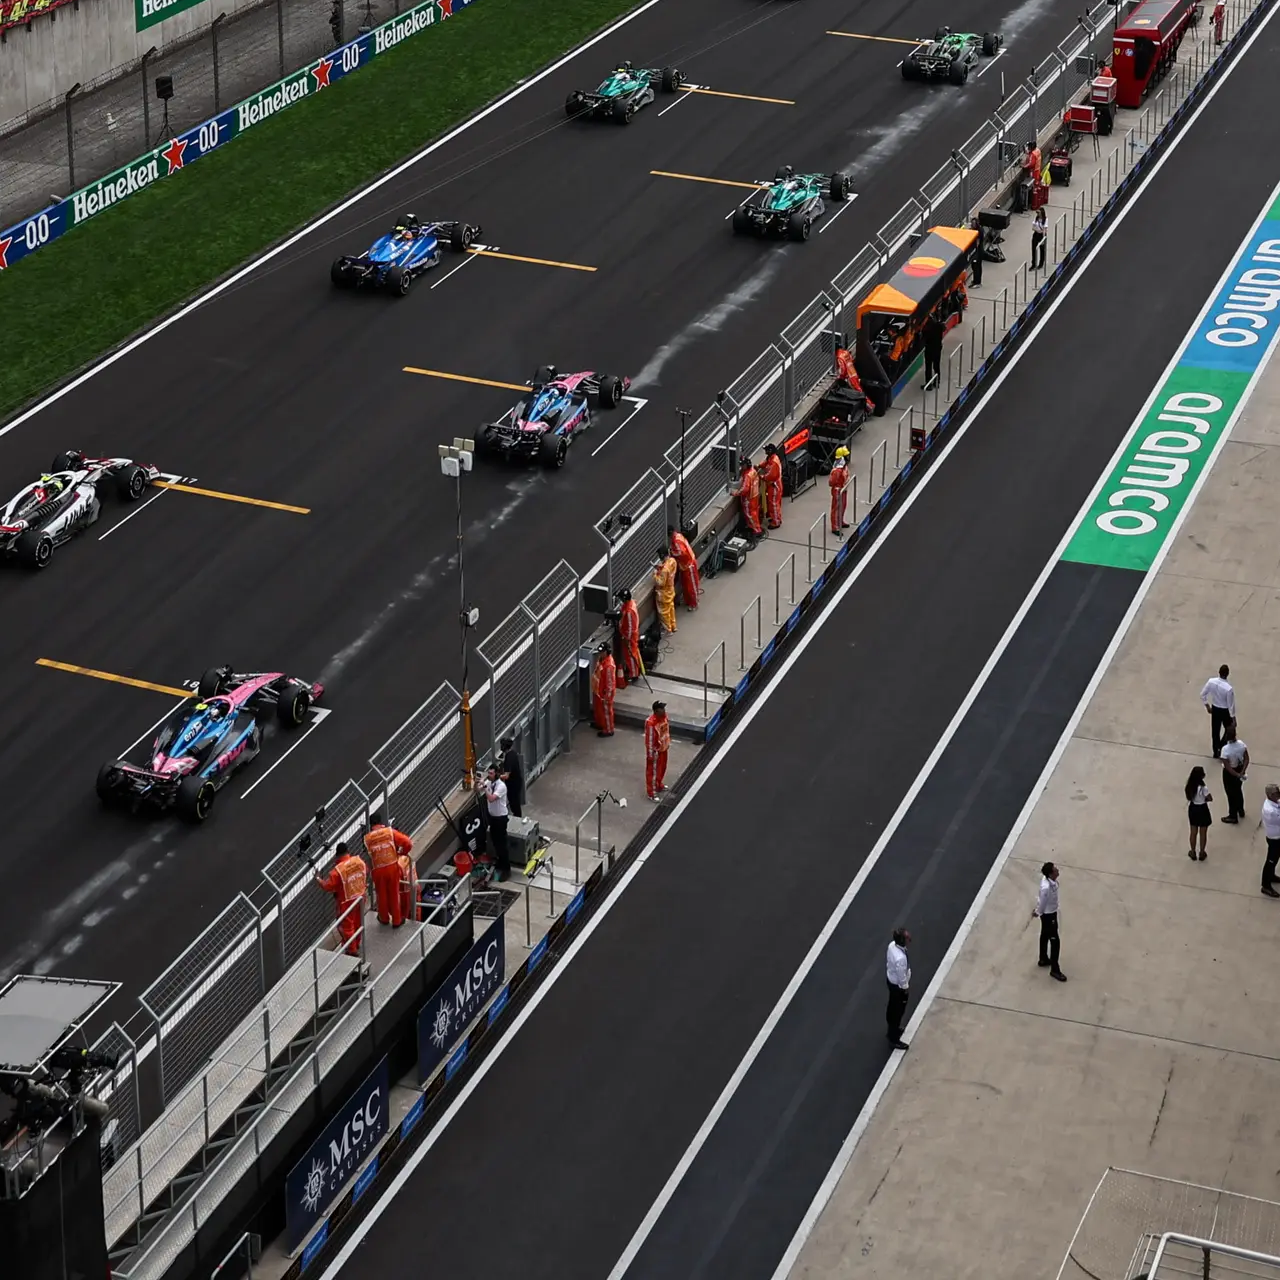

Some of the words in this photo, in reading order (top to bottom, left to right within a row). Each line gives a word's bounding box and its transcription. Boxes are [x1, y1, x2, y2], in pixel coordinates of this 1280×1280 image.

[375, 2, 434, 54] Heineken
[239, 77, 309, 132] Heineken
[72, 158, 159, 224] Heineken
[1096, 392, 1223, 535] aramco
[454, 939, 498, 1015] MSC
[454, 973, 499, 1031] CRUISES
[329, 1086, 380, 1175] MSC
[330, 1121, 381, 1191] CRUISES
